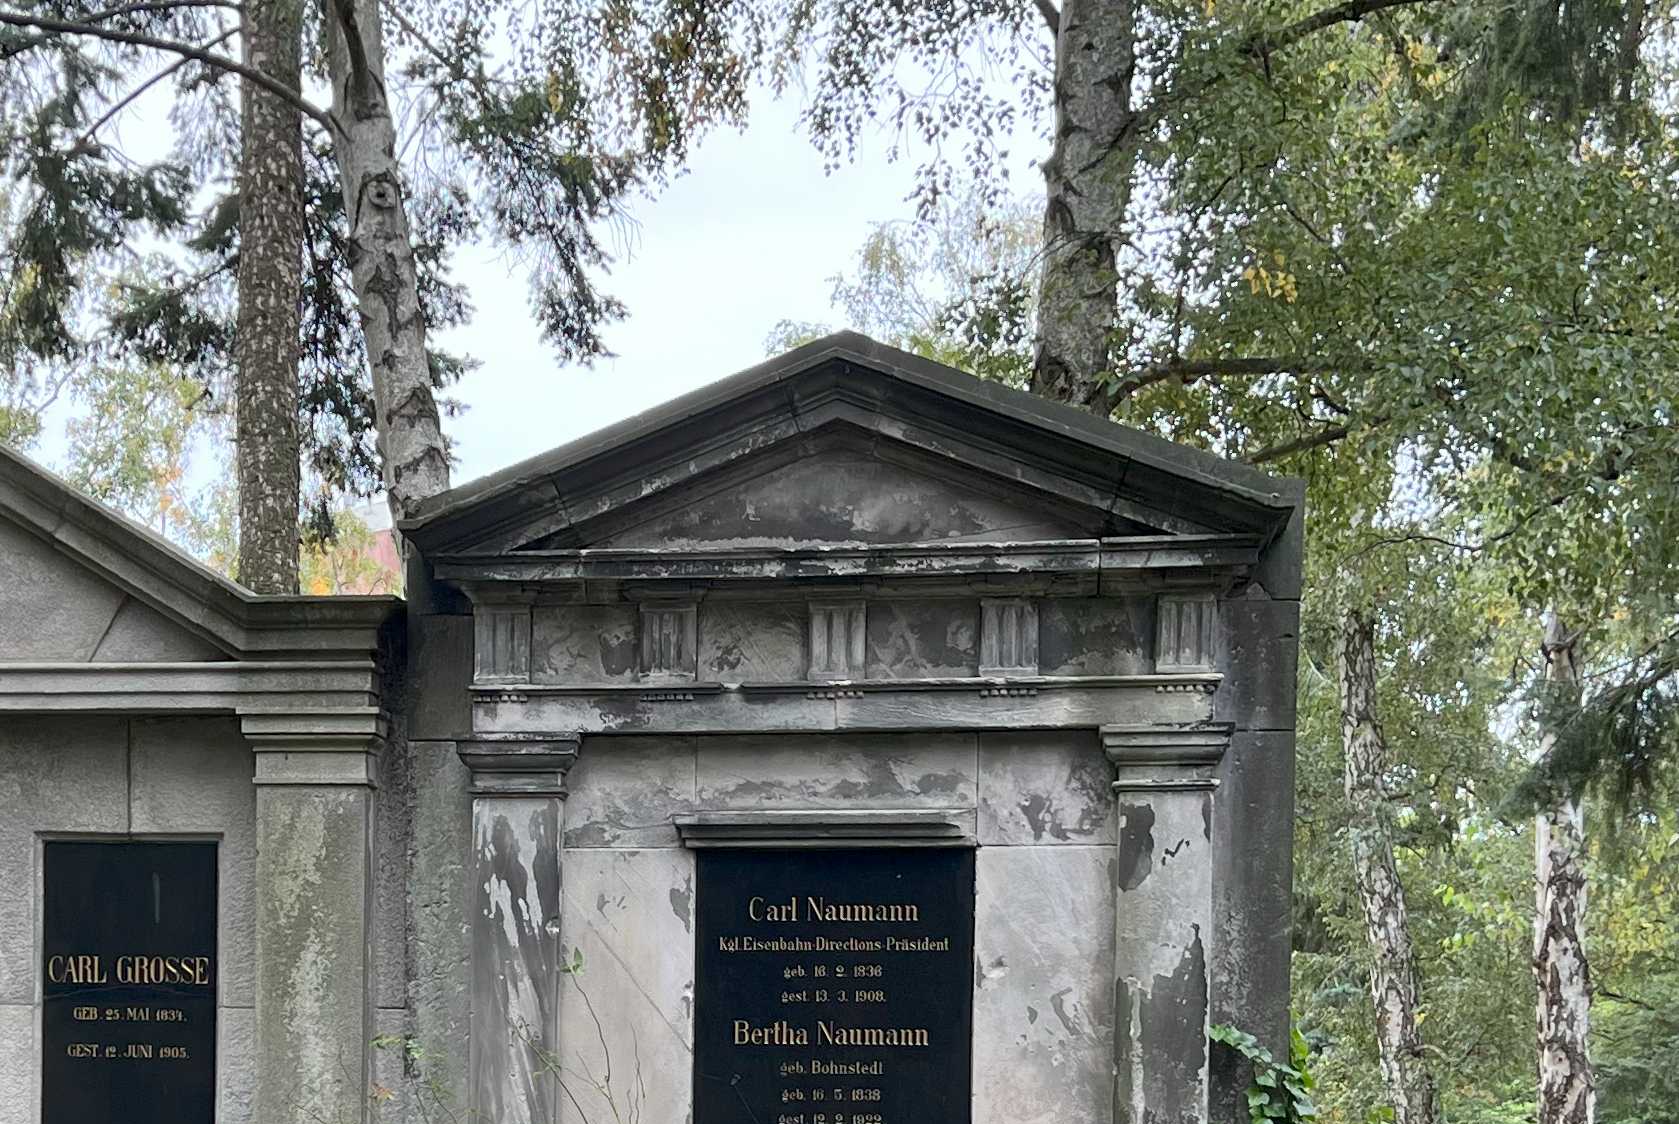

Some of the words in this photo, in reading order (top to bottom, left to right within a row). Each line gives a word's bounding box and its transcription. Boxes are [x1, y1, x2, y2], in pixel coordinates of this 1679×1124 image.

[749, 896, 798, 922] Carl
[807, 896, 919, 922] Naumann
[48, 955, 107, 983] CARL
[116, 956, 209, 985] GROSSE
[783, 965, 807, 979] geb.
[126, 1007, 150, 1021] MAI
[734, 1020, 808, 1045] Bertha
[817, 1020, 929, 1047] Naumann
[123, 1044, 153, 1058] JUNI
[780, 1062, 807, 1076] geb.
[811, 1060, 884, 1075] Bohnstedt
[782, 1089, 807, 1103] geb.
